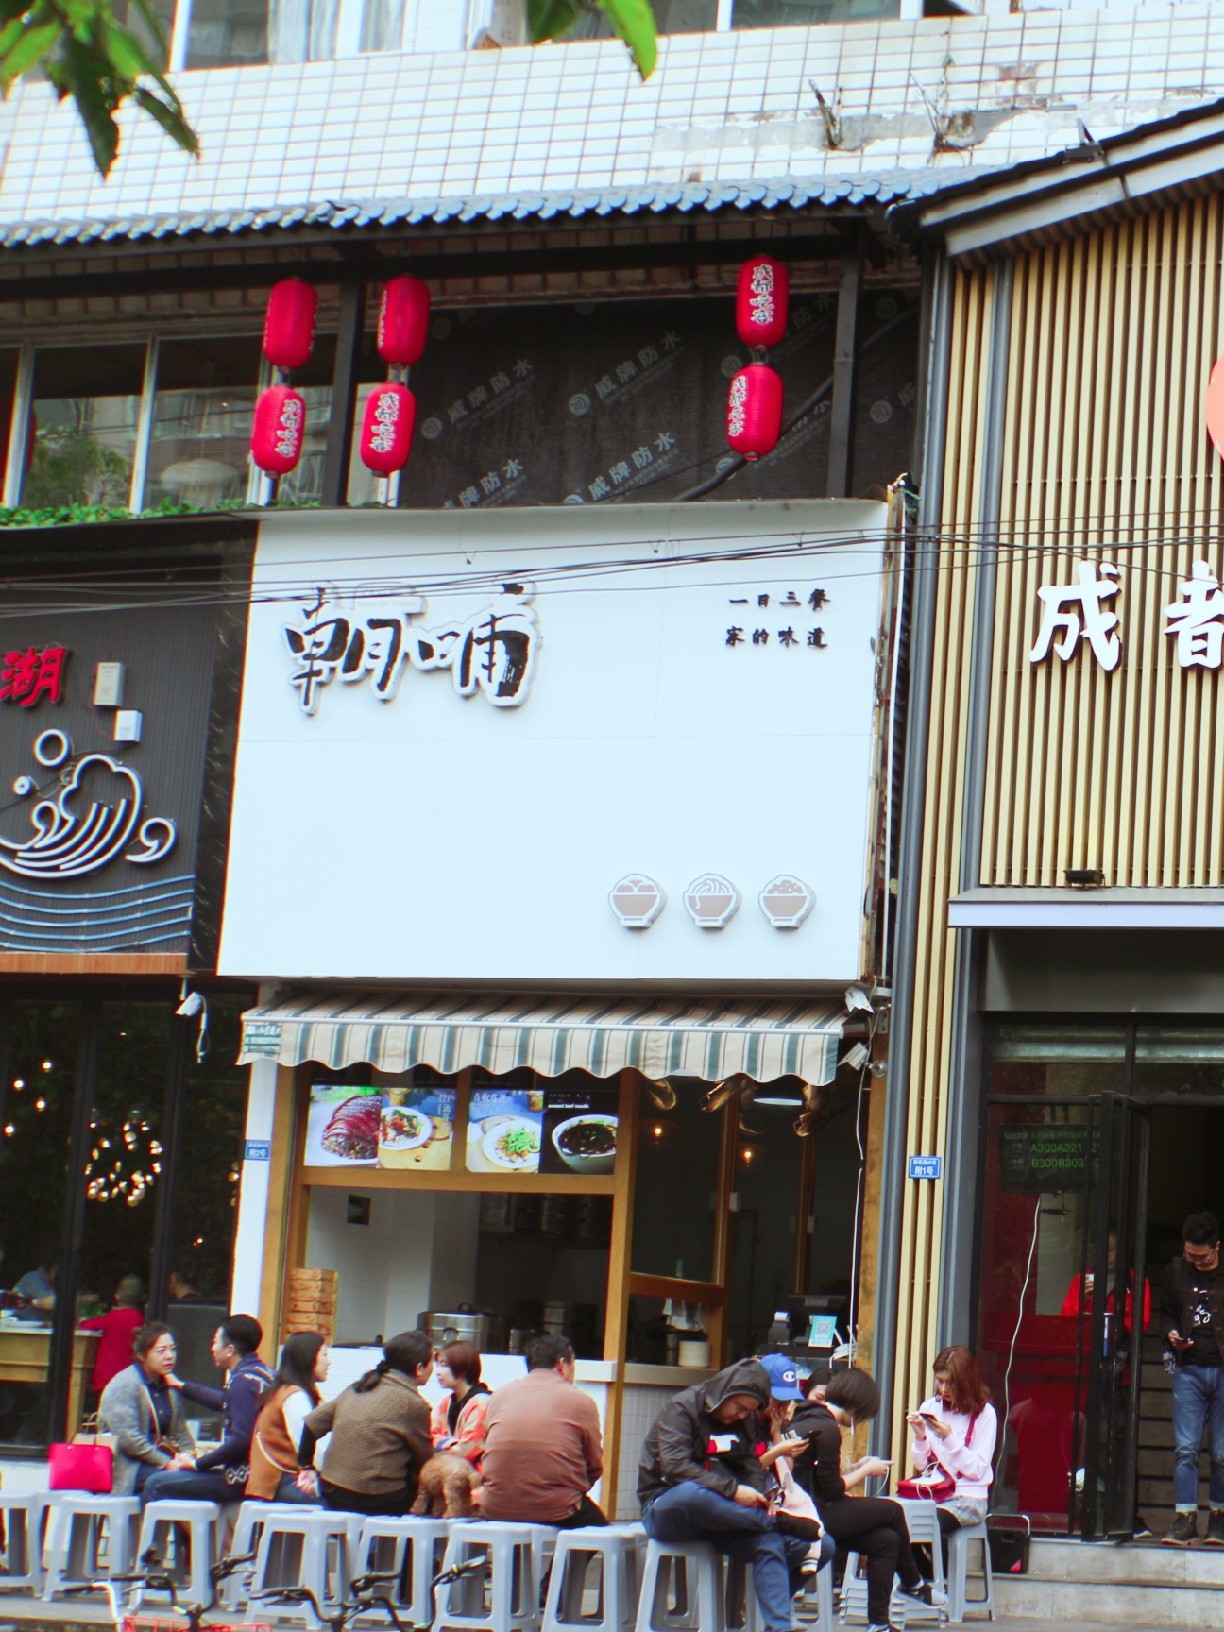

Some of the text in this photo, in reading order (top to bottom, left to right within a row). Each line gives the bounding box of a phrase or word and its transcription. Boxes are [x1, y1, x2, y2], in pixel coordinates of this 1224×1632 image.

[443, 458, 524, 509] 牌防水
[588, 431, 677, 501] 威牌防水
[729, 588, 832, 612] 一日三餐
[725, 625, 829, 650] 家的味道
[0, 646, 67, 705] 湖
